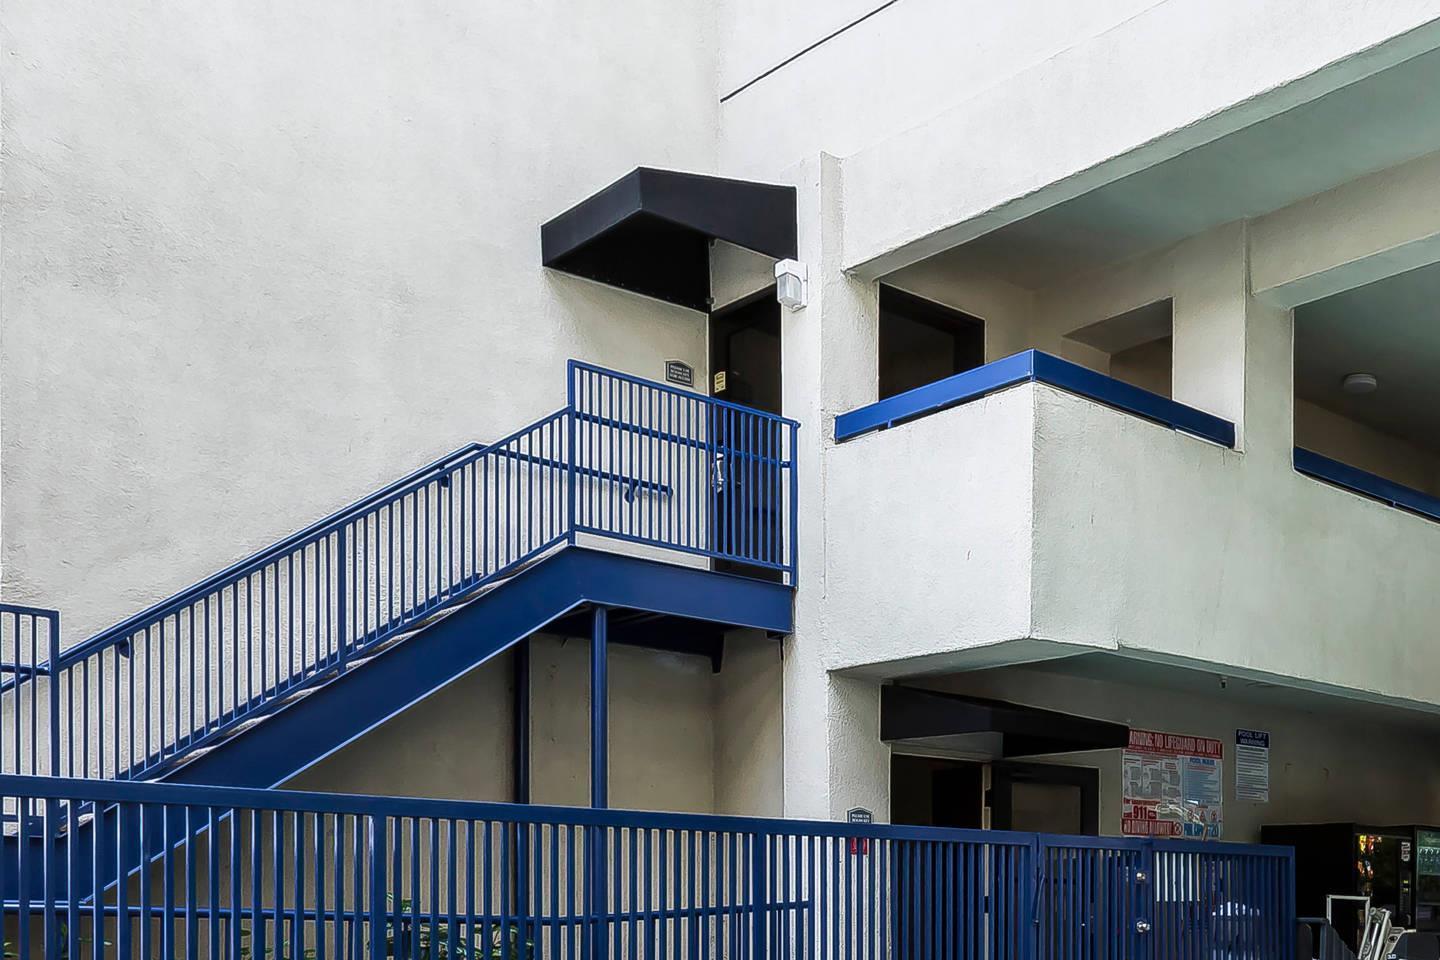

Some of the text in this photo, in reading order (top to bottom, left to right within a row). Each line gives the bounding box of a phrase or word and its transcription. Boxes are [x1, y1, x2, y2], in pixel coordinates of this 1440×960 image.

[1238, 730, 1253, 738] POOL
[1129, 730, 1153, 746] ARNING:
[1154, 735, 1163, 748] NO
[1165, 736, 1195, 751] LIFEGUARD
[1196, 740, 1205, 753] ON
[1206, 740, 1221, 754] DUTY
[1133, 805, 1148, 819] 911
